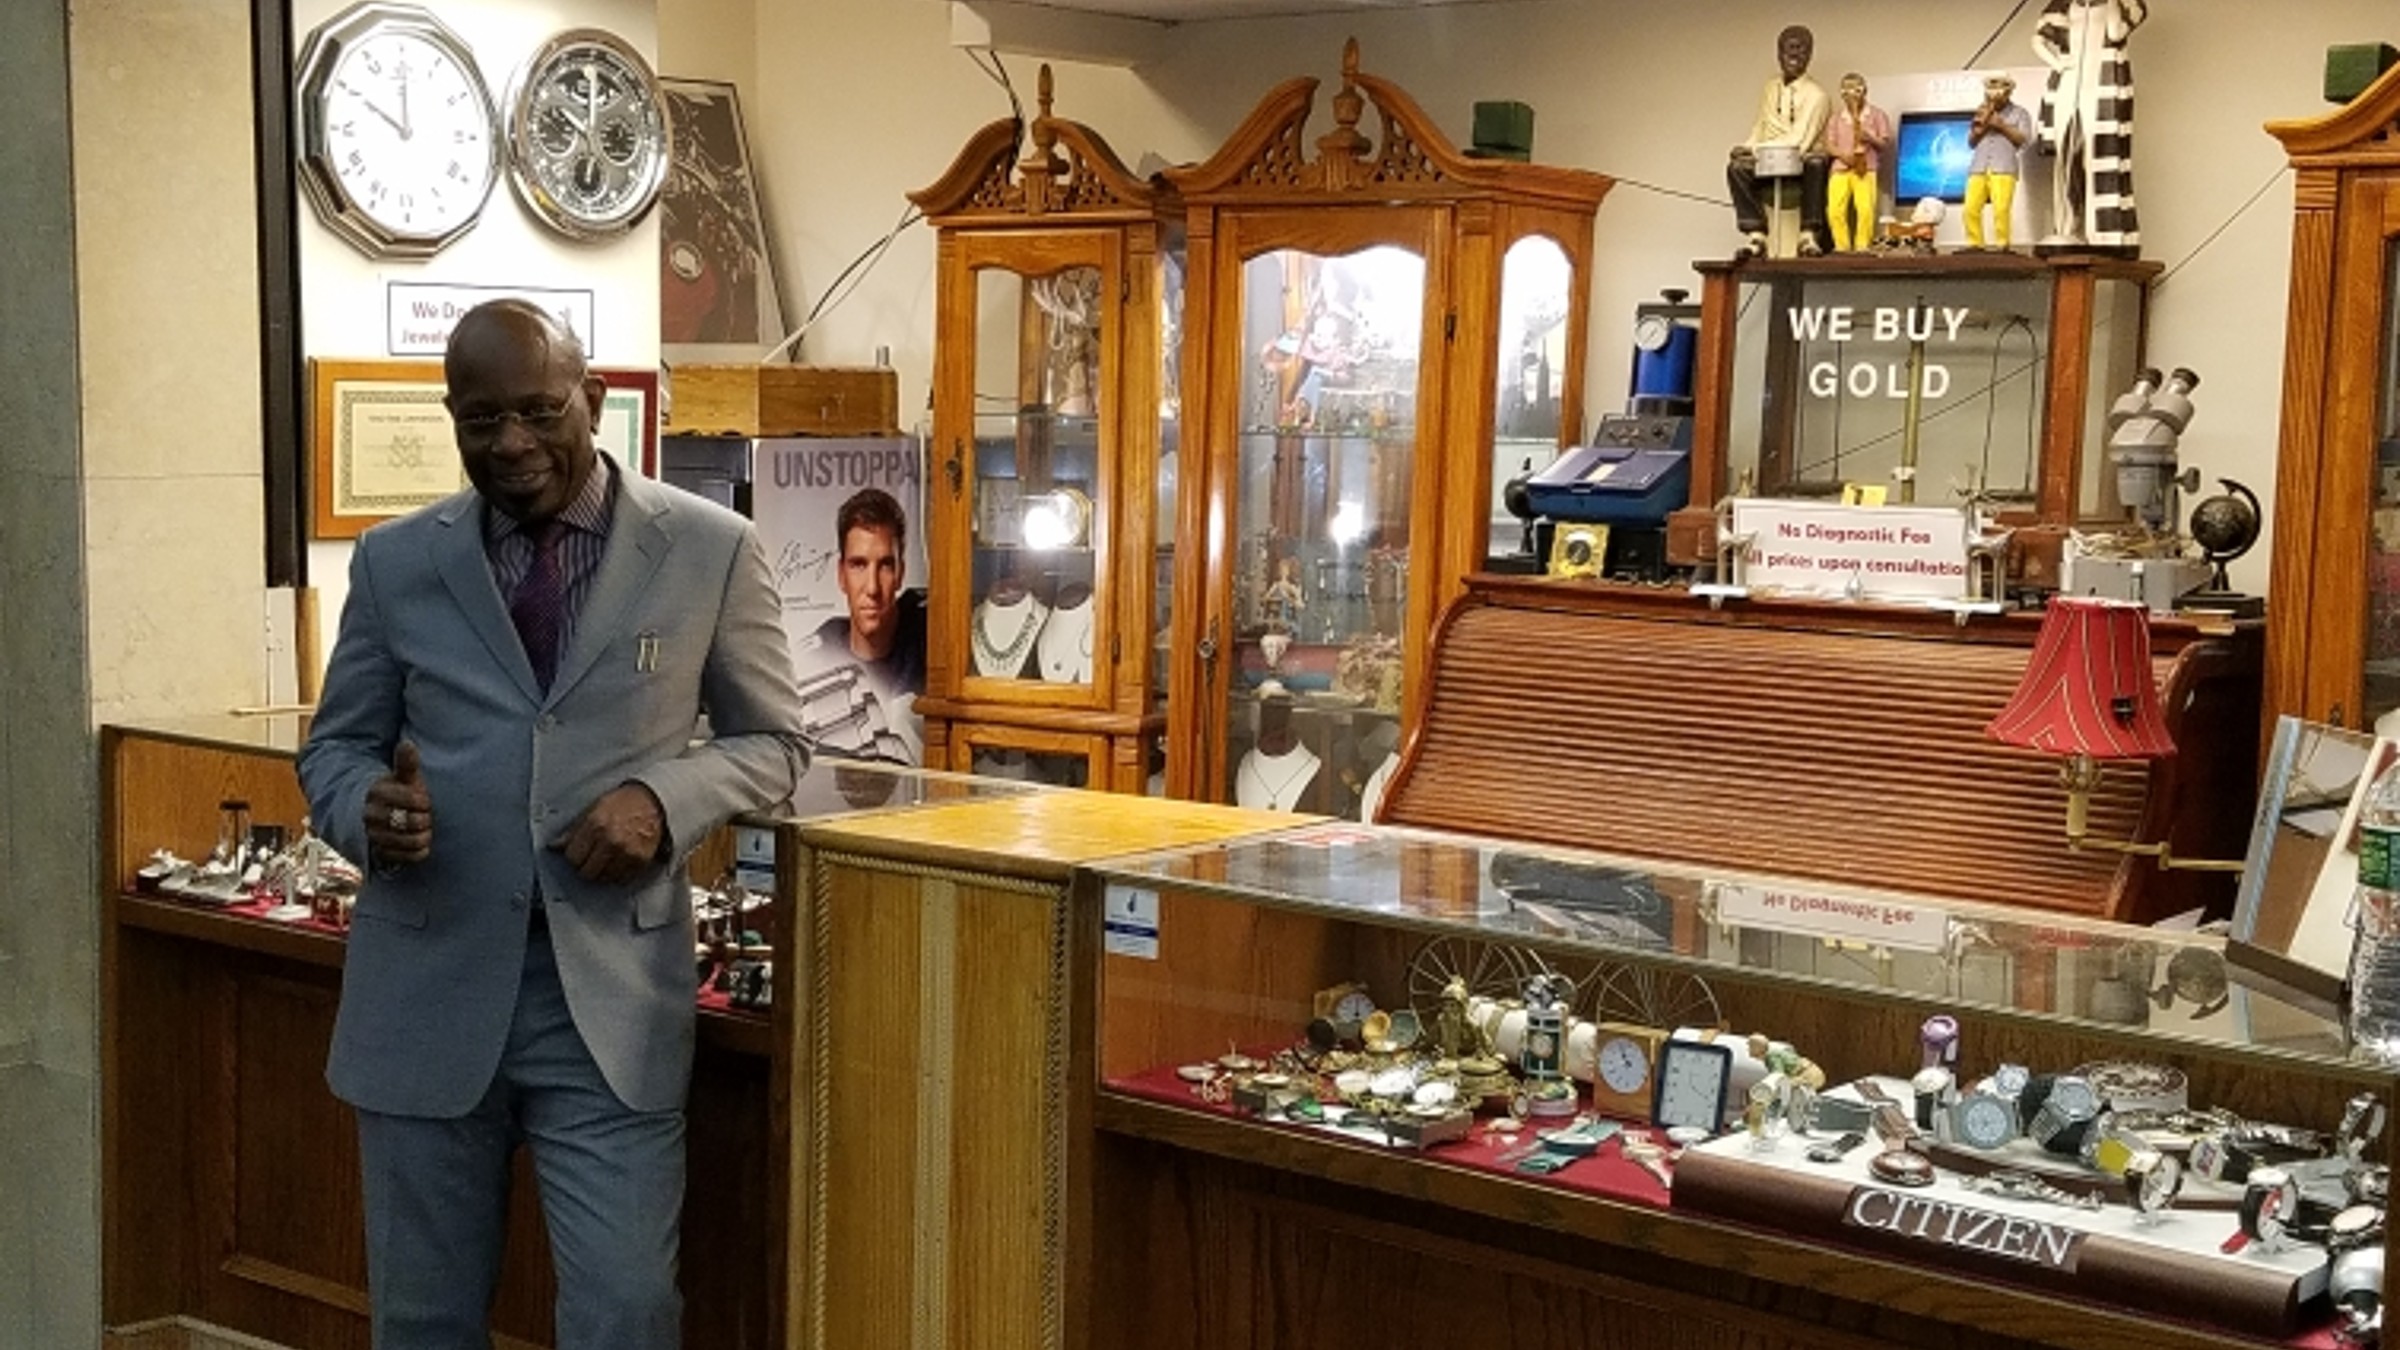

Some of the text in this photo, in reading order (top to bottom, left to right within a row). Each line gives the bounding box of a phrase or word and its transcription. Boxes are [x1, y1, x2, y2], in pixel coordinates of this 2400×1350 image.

[412, 302, 439, 319] We
[1789, 307, 1970, 341] WE BUY
[1808, 362, 1951, 399] GOLD
[1777, 523, 1931, 545] No Diagnostic Fee
[1767, 553, 1813, 570] prices
[1818, 557, 1861, 575] upon
[1866, 559, 1968, 577] consultatio
[1852, 1189, 2075, 1266] CITIZEN
